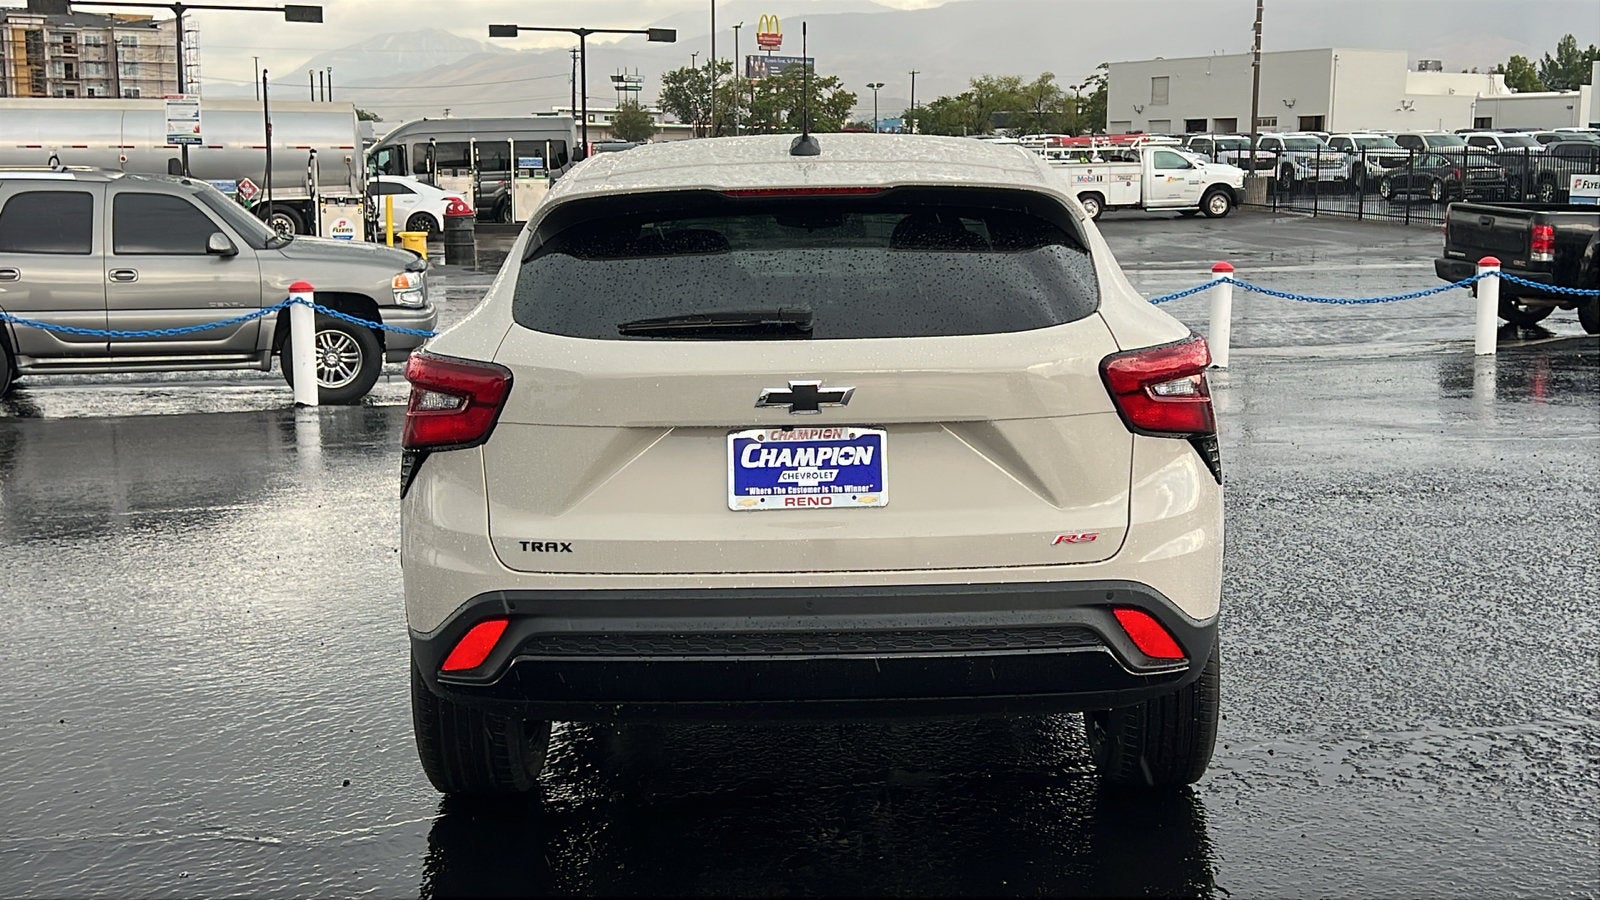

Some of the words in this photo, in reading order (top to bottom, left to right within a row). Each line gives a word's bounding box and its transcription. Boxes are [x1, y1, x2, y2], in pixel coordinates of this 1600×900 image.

[1583, 180, 1600, 189] FLYE
[770, 428, 843, 441] CHAMPION
[741, 443, 874, 468] CHAMPION
[782, 472, 833, 480] CHEVROLET
[773, 486, 786, 495] The
[788, 486, 821, 495] Customer
[821, 485, 829, 493] Is
[830, 485, 843, 493] The
[785, 496, 832, 507] RENO
[1051, 532, 1099, 545] RS
[519, 541, 573, 552] TRAX
